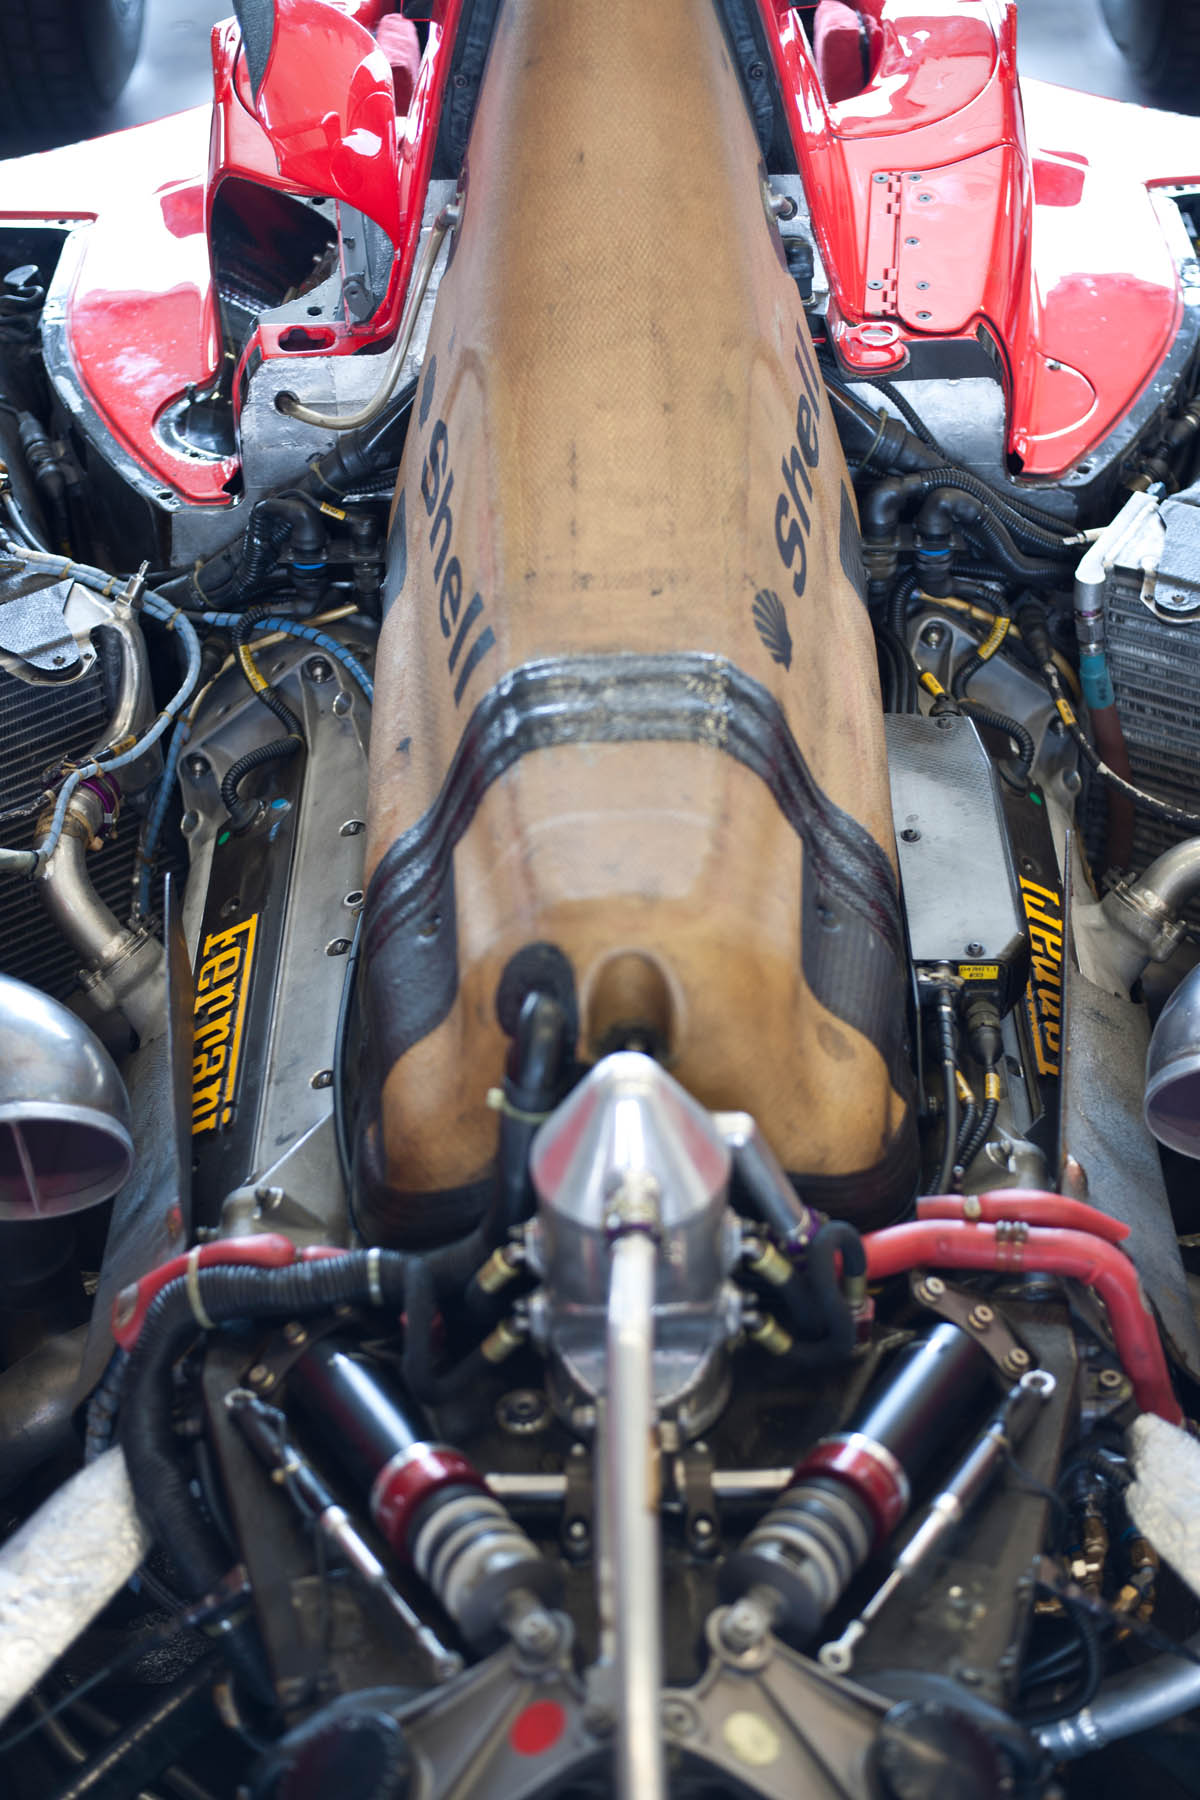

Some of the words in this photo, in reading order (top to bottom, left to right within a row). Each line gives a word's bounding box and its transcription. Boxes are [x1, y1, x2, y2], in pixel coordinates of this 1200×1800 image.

[420, 419, 496, 709] Shell
[774, 319, 820, 598] Shell
[192, 912, 258, 1135] Ferrari
